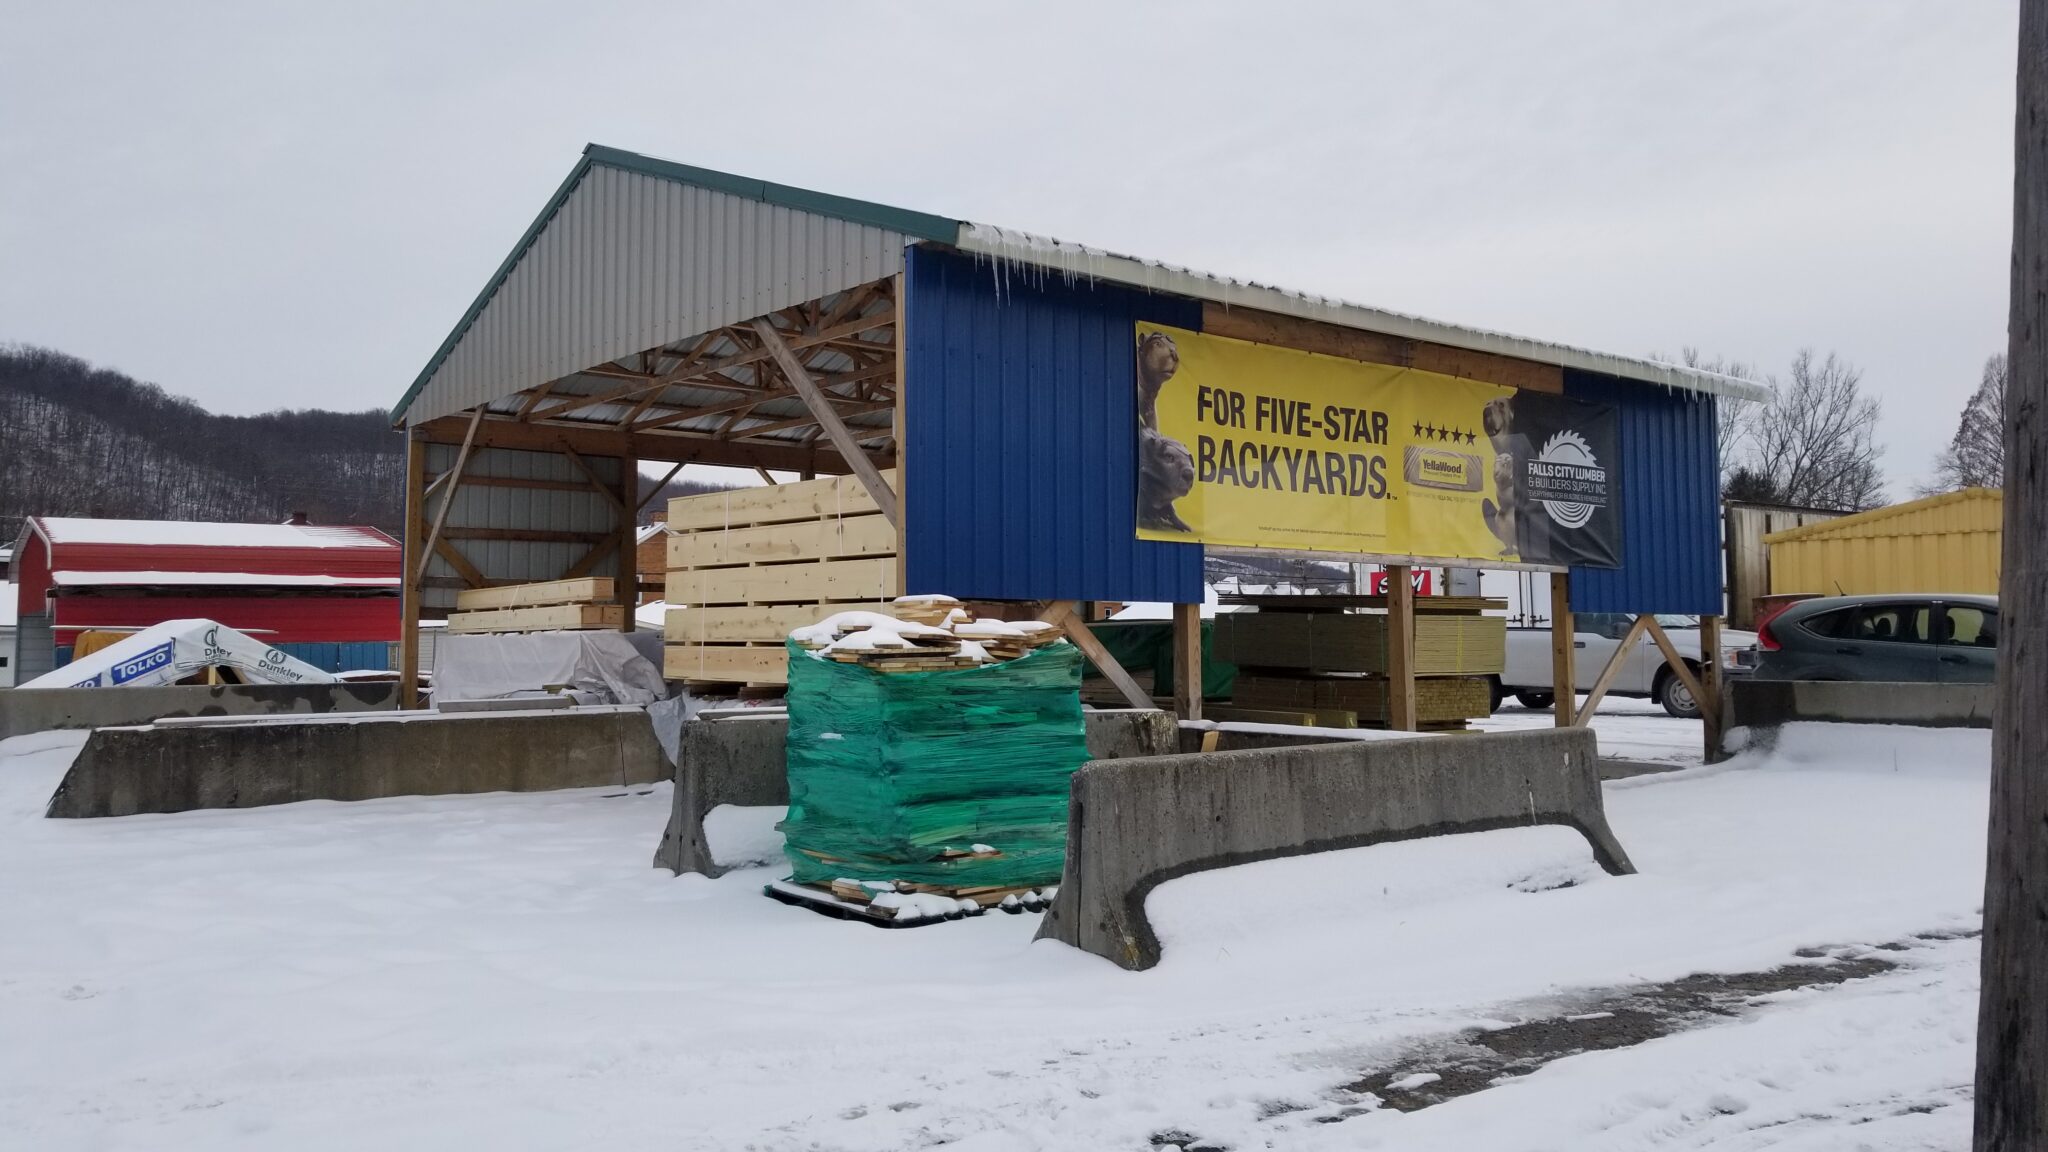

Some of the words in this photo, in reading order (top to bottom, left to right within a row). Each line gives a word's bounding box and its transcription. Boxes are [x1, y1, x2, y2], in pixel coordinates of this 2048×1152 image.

[1197, 385, 1246, 429] FOR
[1256, 395, 1389, 445] FIVE-STAR
[1197, 434, 1391, 500] BACKYARDS.
[1528, 462, 1554, 477] FALLS
[1555, 466, 1575, 479] CITY
[1575, 468, 1606, 483] LUMBER
[1535, 477, 1571, 491] BUILDERS
[1572, 481, 1595, 494] SUPPLY
[114, 646, 169, 679] TOLKO
[258, 660, 304, 682] Dunkley
